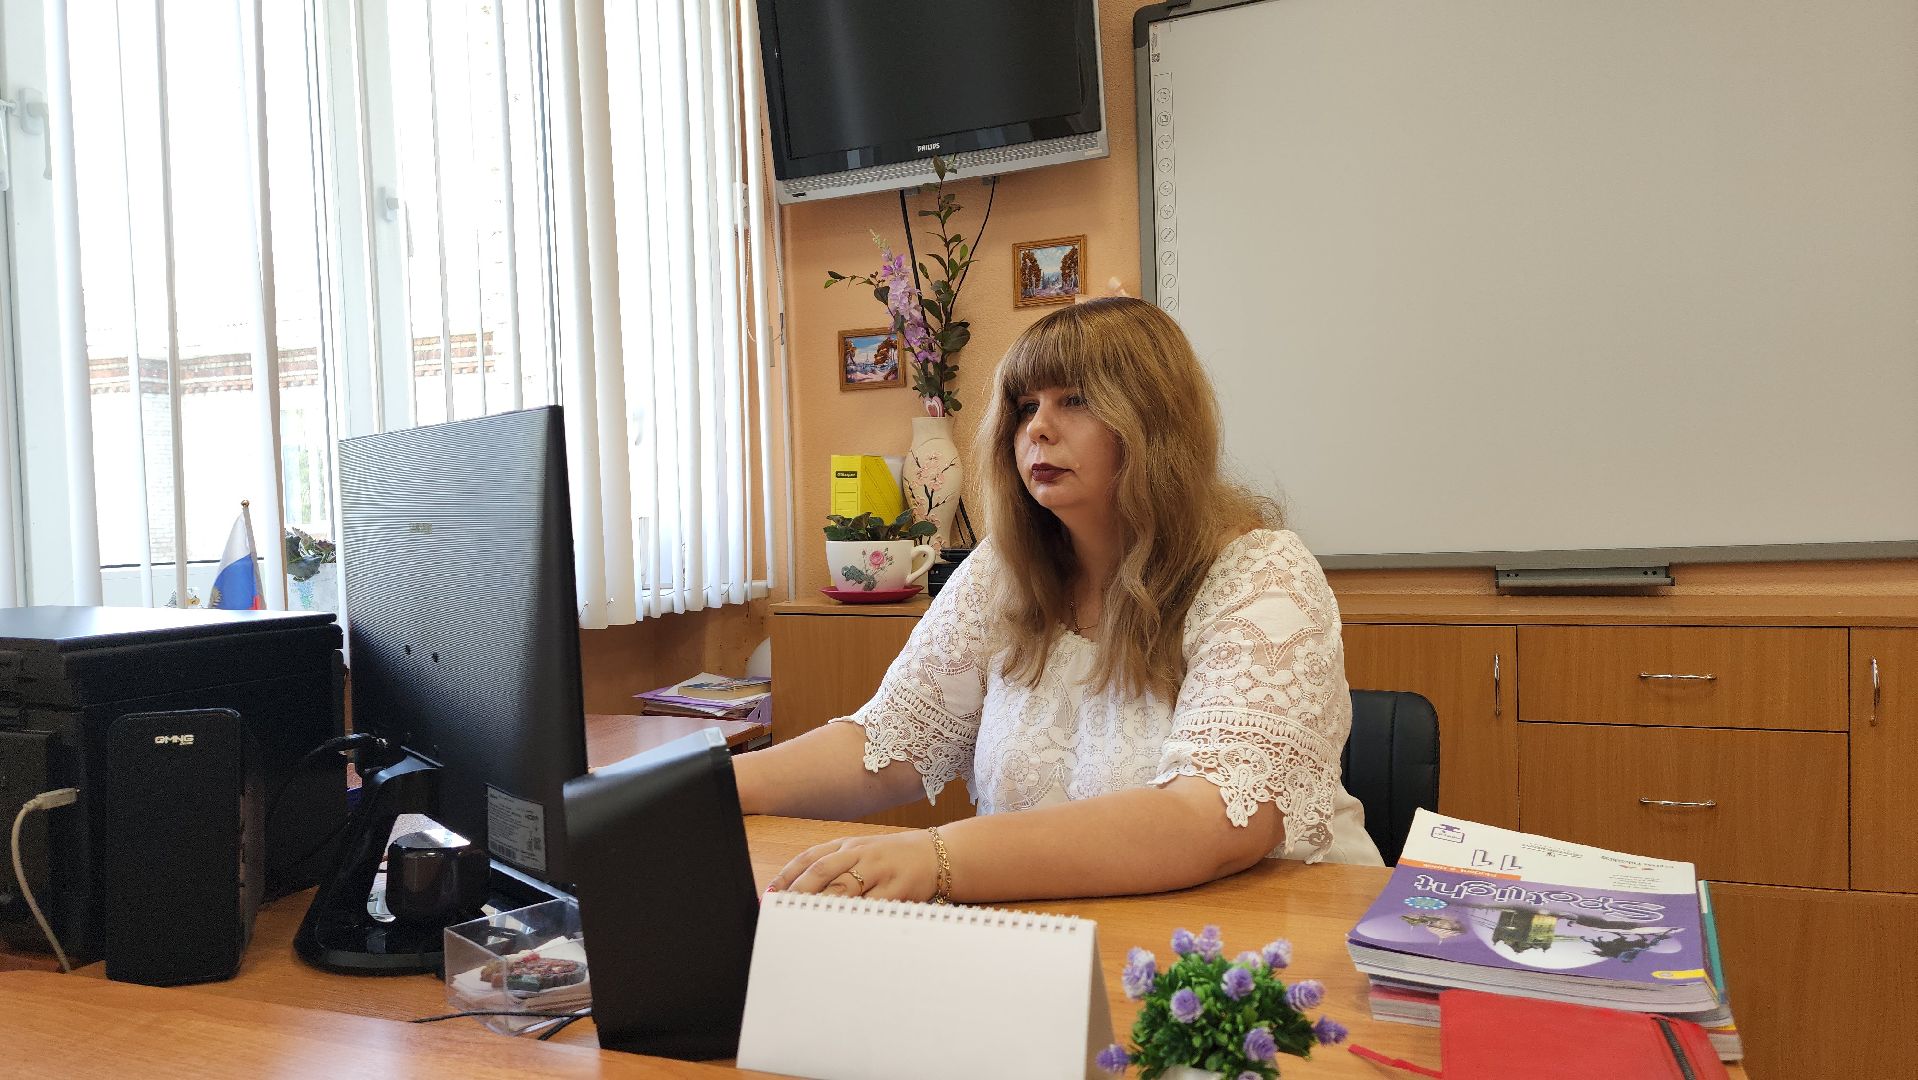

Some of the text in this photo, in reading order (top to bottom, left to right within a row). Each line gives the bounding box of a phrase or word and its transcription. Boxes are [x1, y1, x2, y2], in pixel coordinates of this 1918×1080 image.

[917, 142, 940, 153] PHILIPS
[1471, 849, 1523, 871] 11
[1414, 874, 1665, 921] Spotlight
